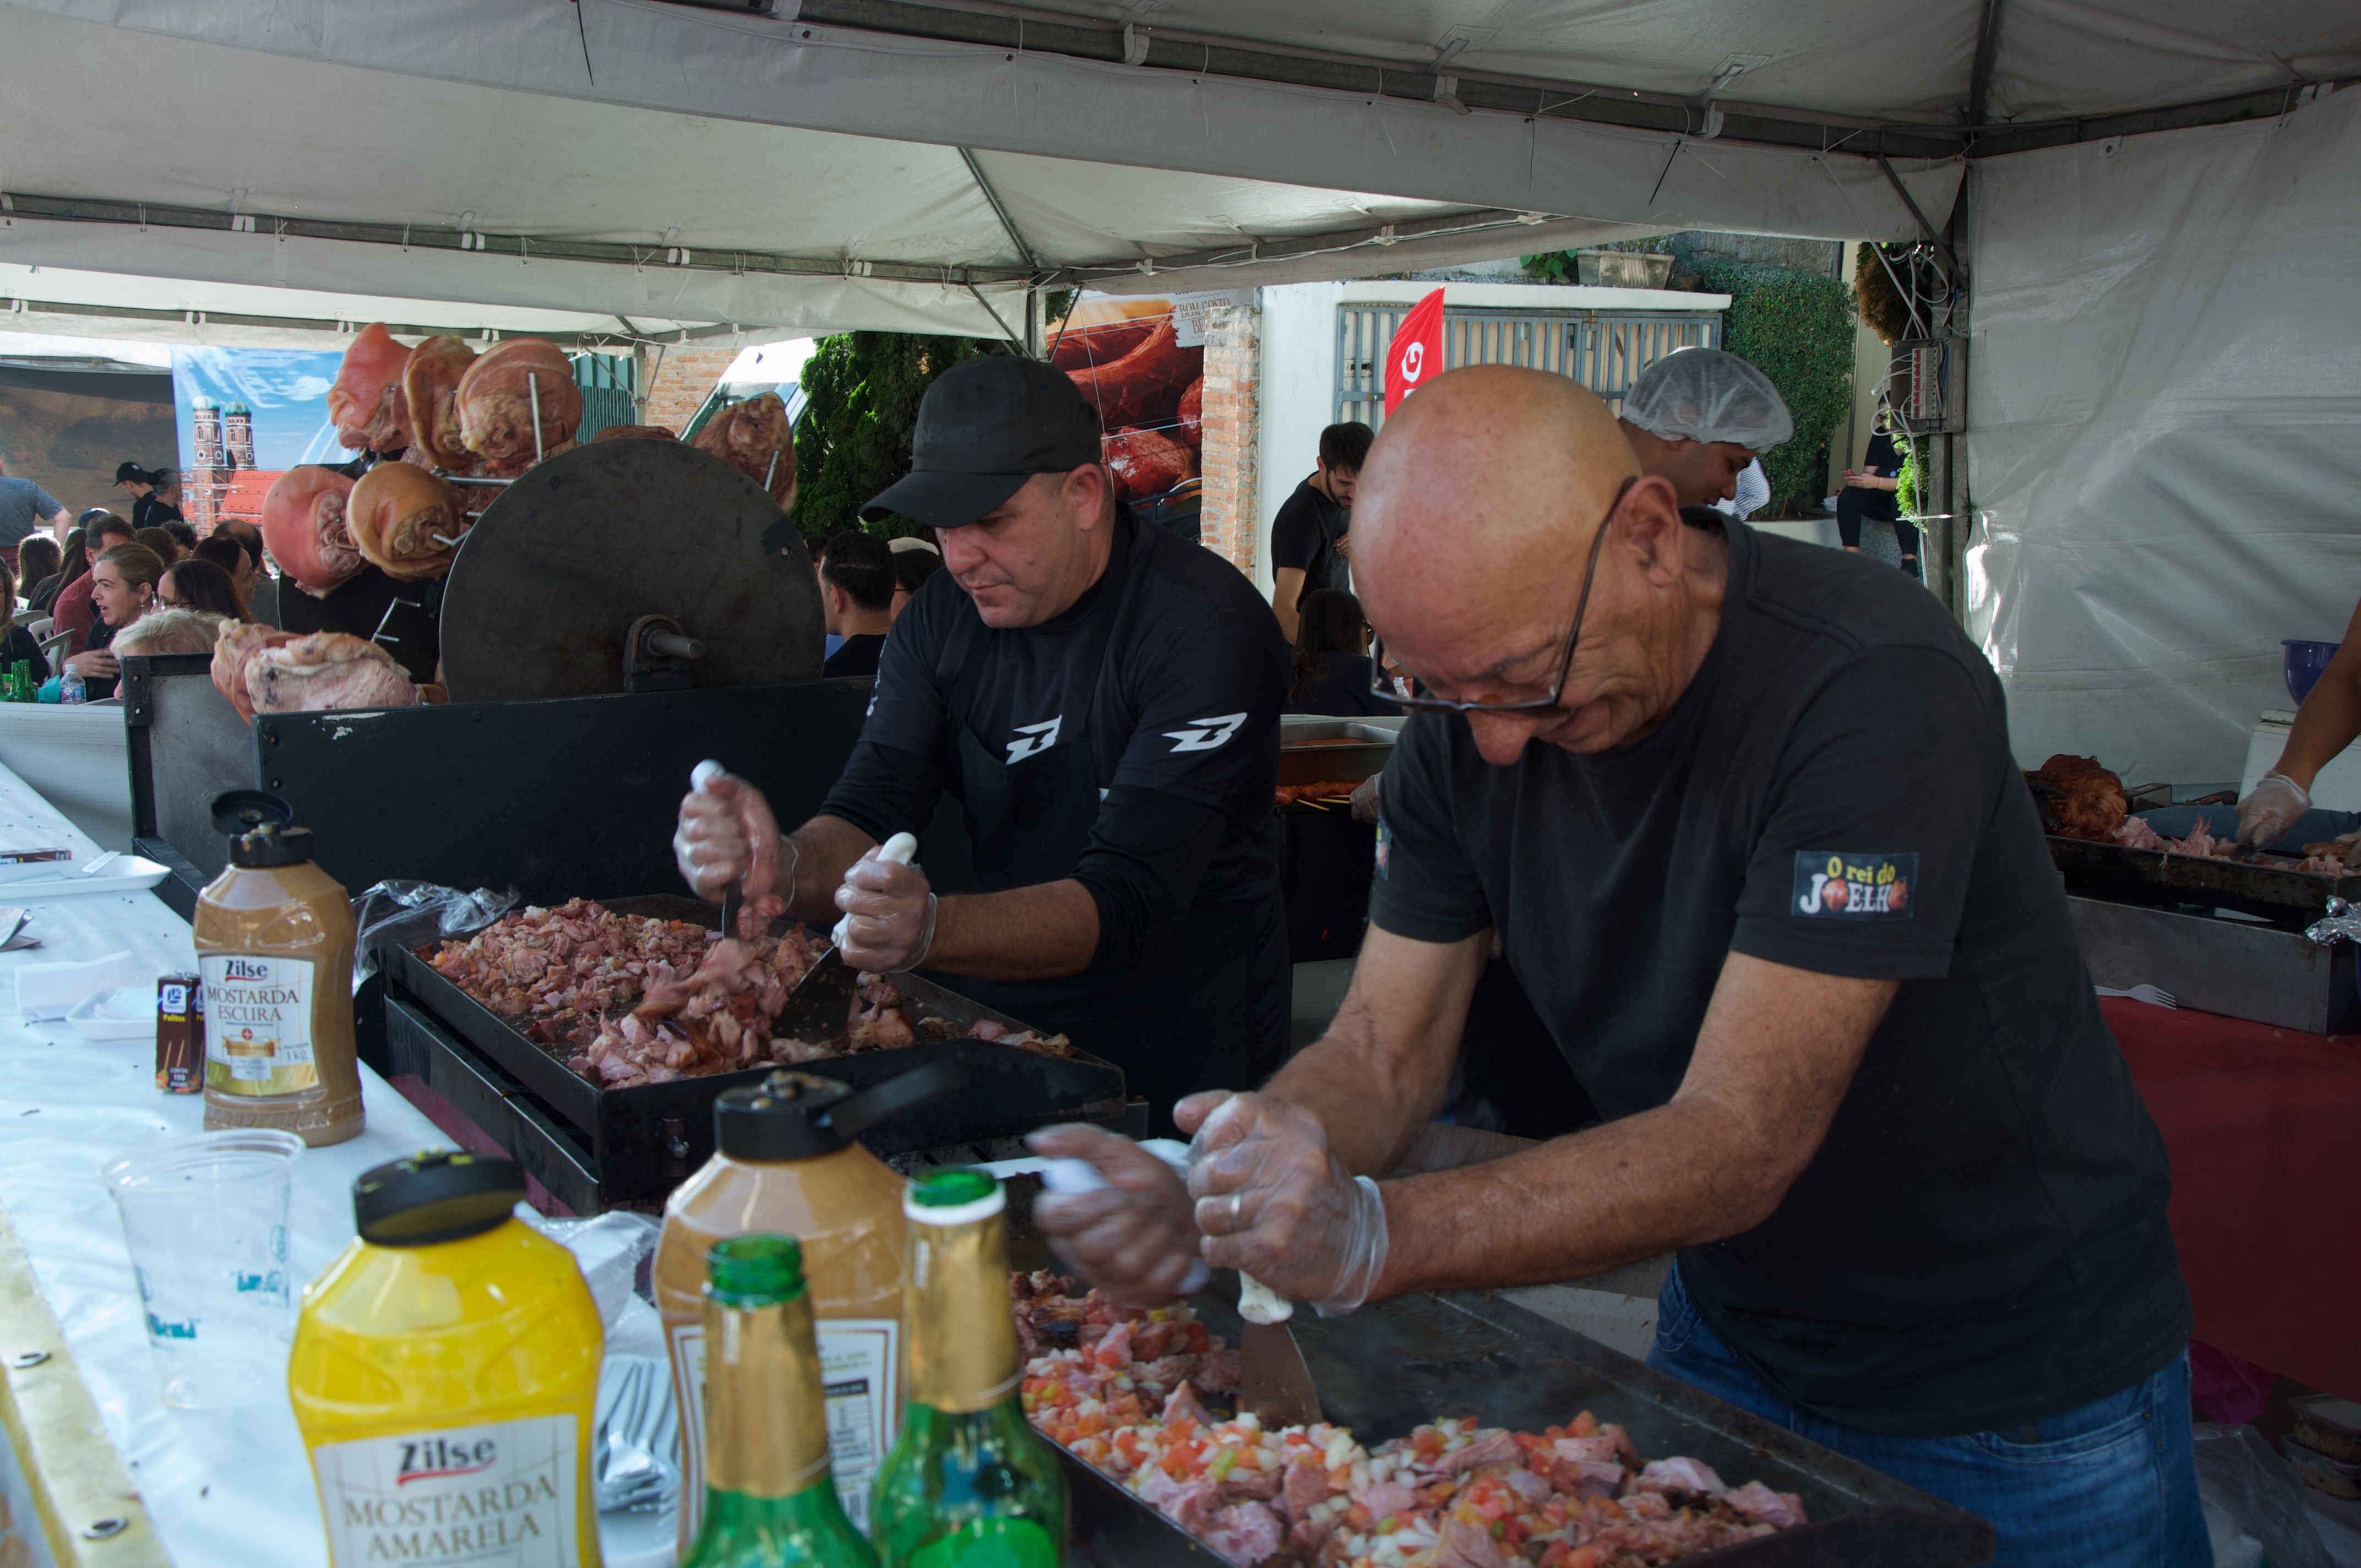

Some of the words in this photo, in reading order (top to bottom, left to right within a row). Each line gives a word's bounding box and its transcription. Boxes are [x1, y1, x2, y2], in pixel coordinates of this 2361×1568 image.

[1179, 302, 1201, 318] BOM
[1191, 319, 1206, 334] BE
[1826, 856, 1843, 878] O
[1846, 865, 1873, 884] rei
[1876, 862, 1896, 885] do
[226, 959, 268, 977] Zilse
[206, 986, 300, 1005] MOSTARDA
[218, 1005, 282, 1021] ESCURA
[398, 1437, 496, 1472] Zilse
[345, 1473, 557, 1529] MOSTARDA
[366, 1512, 542, 1561] AMARELA
